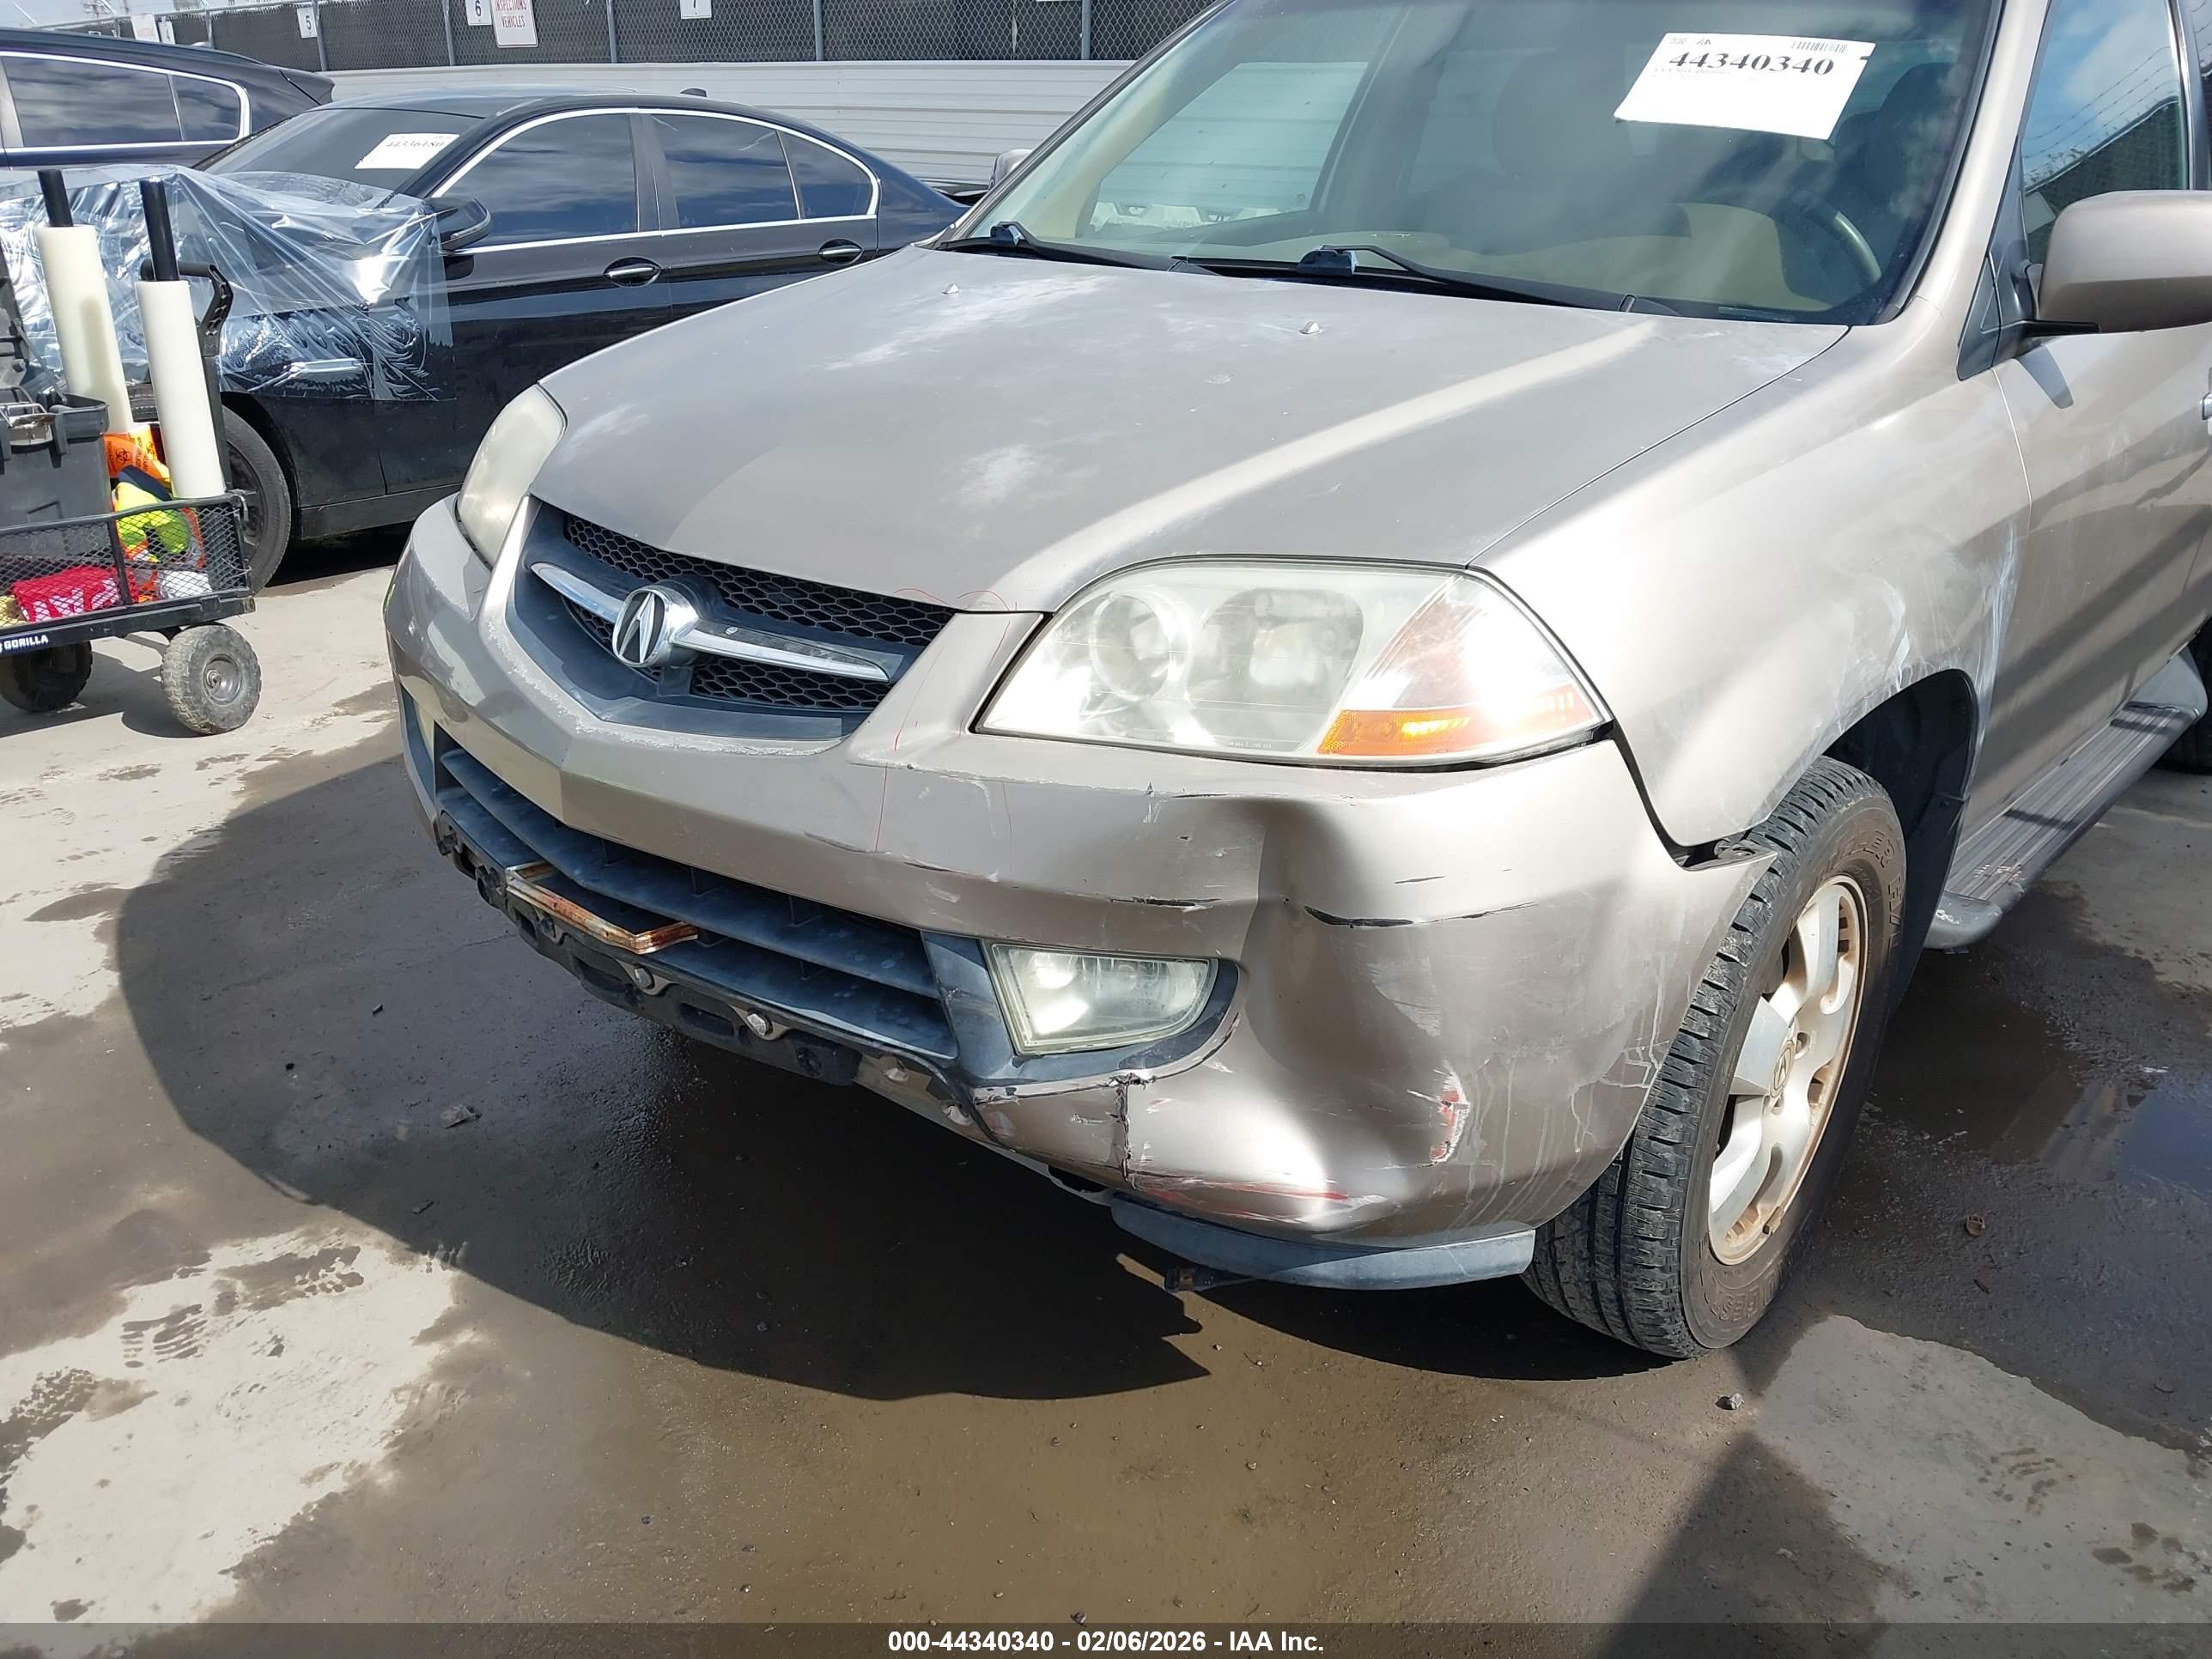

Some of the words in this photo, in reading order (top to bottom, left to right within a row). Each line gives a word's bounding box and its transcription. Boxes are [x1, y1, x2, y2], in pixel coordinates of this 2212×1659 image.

[475, 0, 482, 16] 6
[306, 15, 312, 29] 5
[501, 15, 526, 27] VEHICLES
[1669, 52, 1834, 75] 44340340
[3, 635, 49, 650] GORILLA
